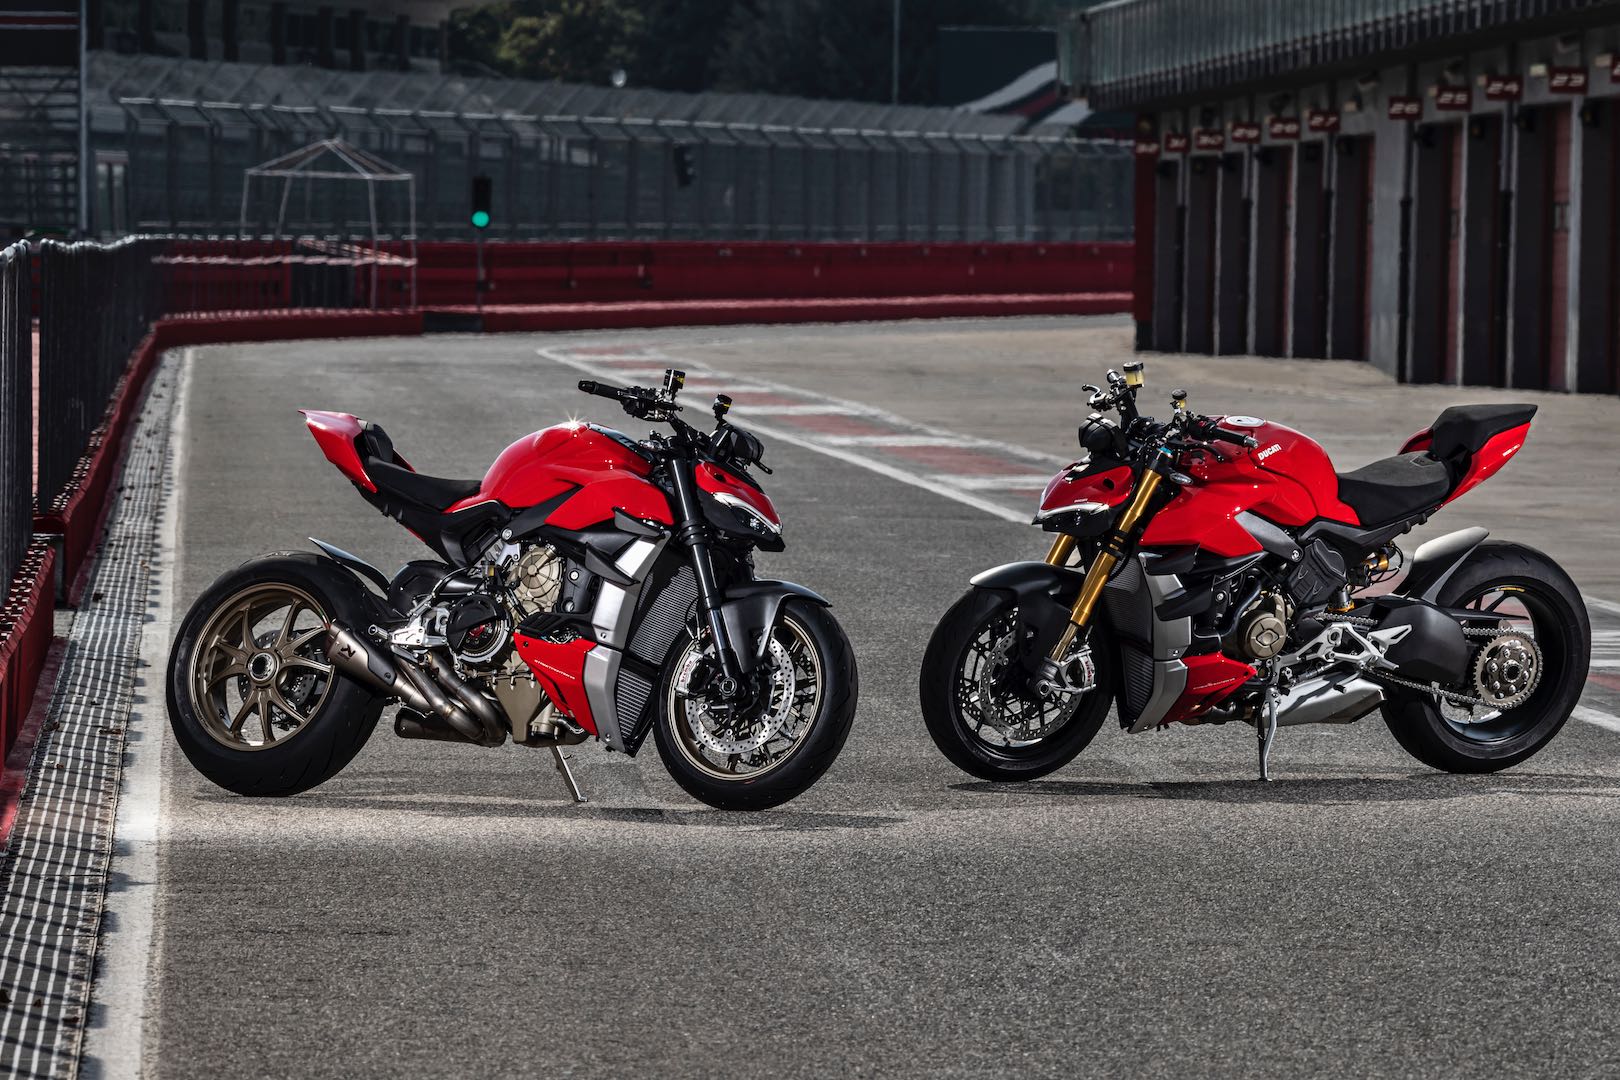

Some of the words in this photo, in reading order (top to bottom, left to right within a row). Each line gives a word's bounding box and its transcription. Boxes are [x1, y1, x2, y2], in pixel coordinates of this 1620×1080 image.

[1551, 73, 1584, 87] 23
[1487, 81, 1519, 95] 24
[1439, 92, 1468, 104] 25
[1390, 102, 1419, 115] 26
[1311, 115, 1337, 127] 27
[1257, 443, 1282, 461] DUCATI
